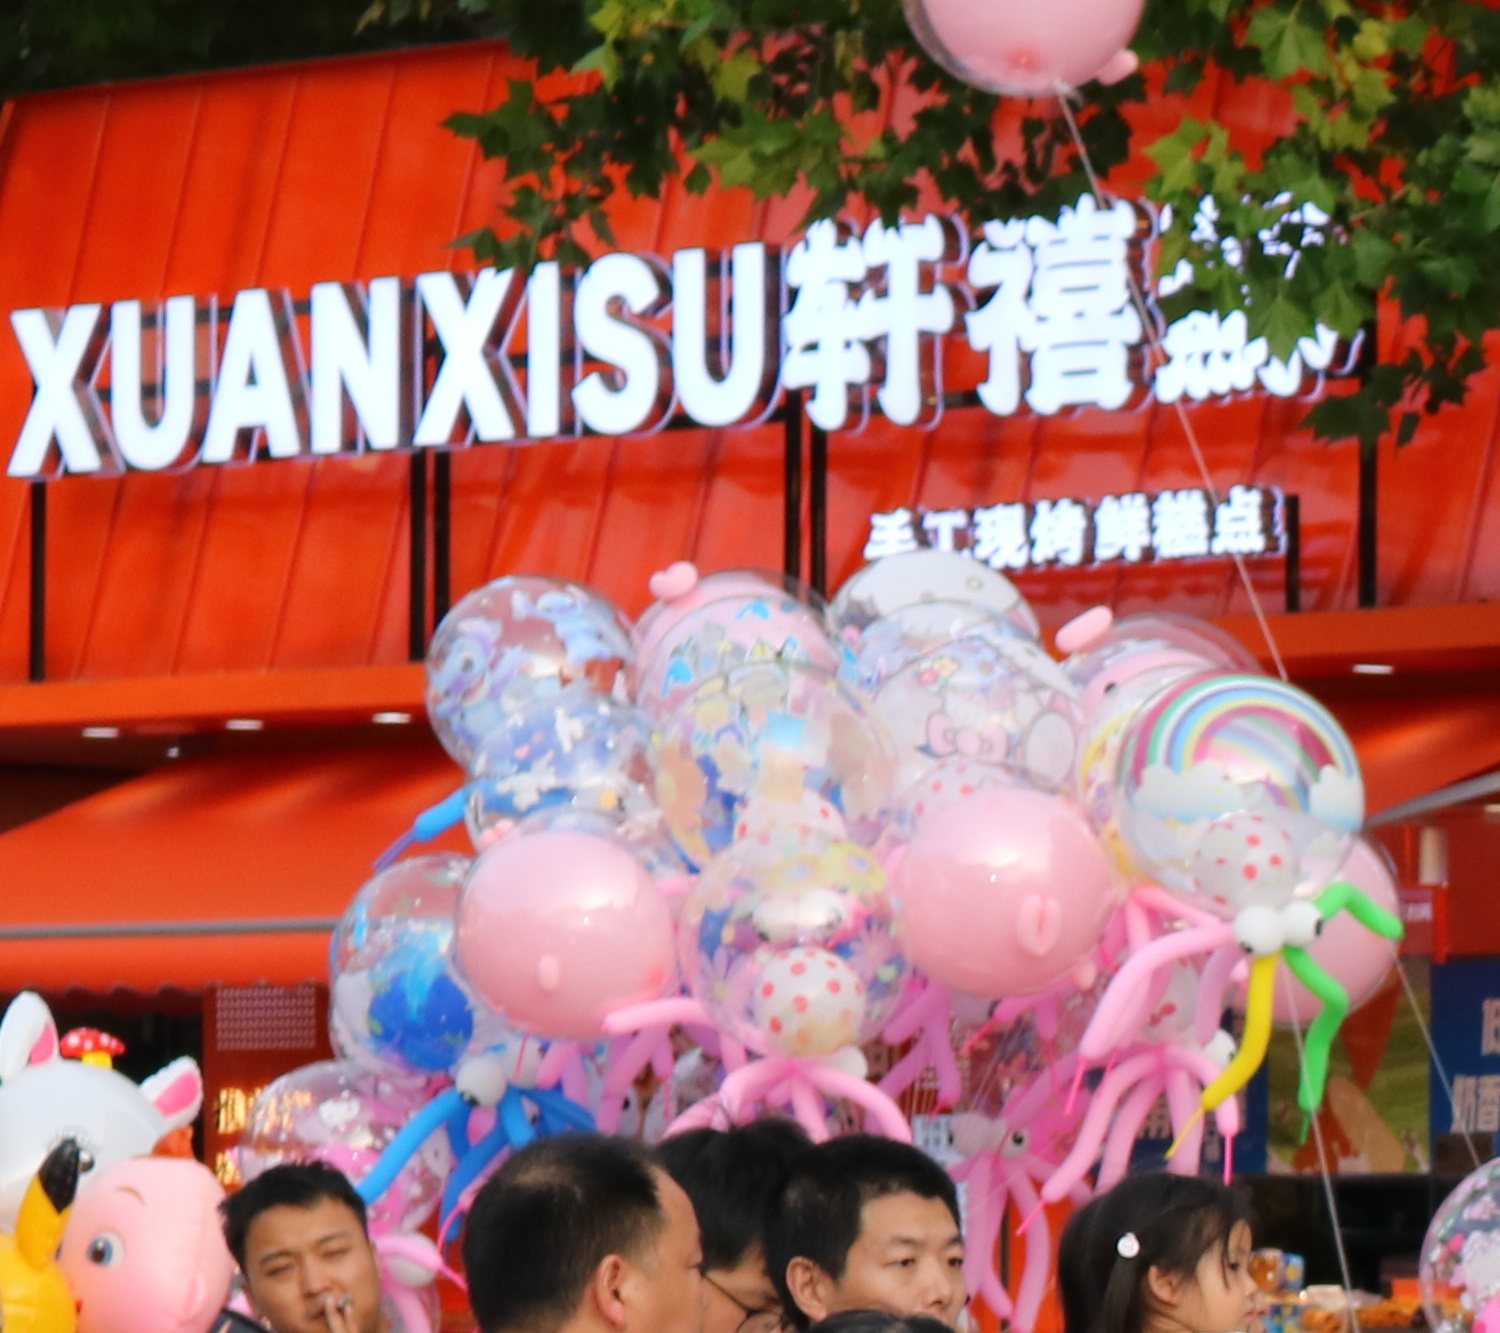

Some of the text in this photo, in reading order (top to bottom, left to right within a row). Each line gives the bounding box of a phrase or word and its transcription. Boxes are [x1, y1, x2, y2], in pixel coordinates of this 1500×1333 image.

[863, 484, 1269, 569] 手工现烤鲜糕点
